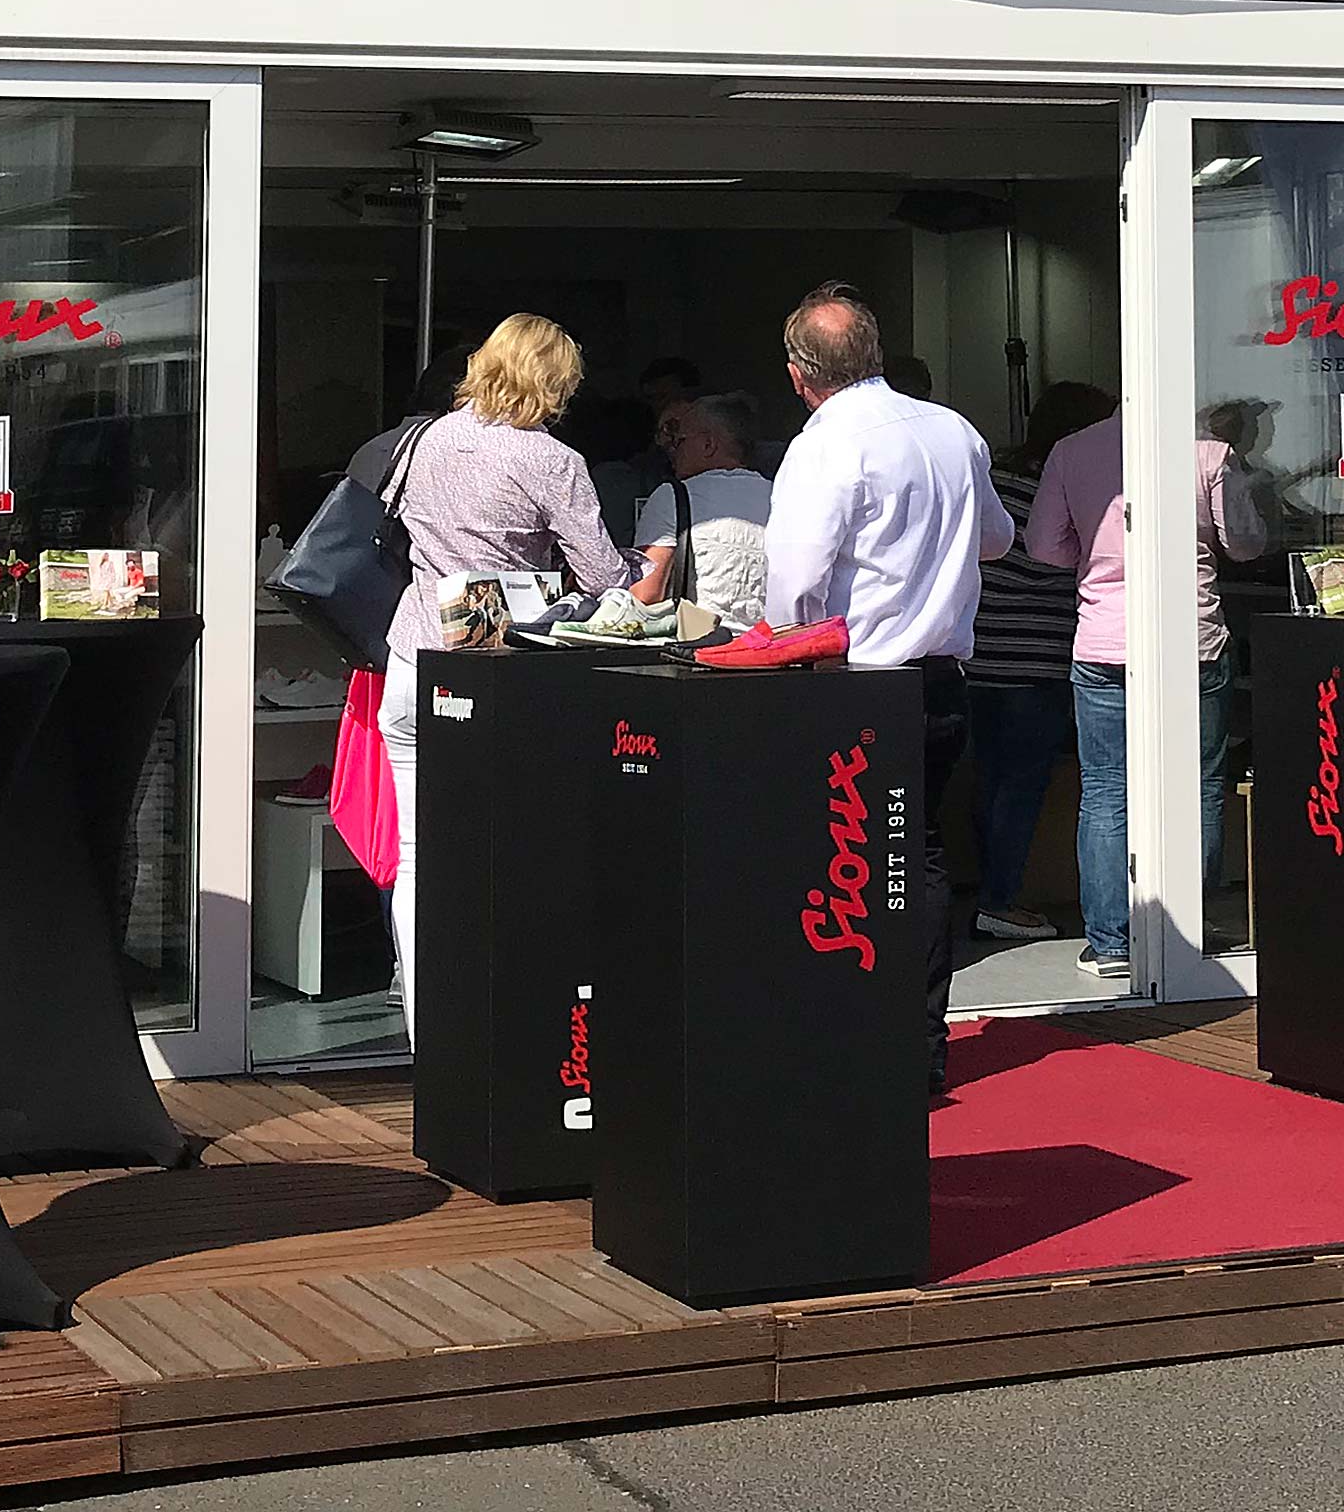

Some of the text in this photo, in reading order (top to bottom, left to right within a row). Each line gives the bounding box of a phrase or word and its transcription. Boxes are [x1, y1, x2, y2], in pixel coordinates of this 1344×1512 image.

[612, 719, 657, 756] Sioux
[1308, 678, 1344, 857] Sioux
[800, 744, 875, 972] Sioux
[887, 787, 905, 910] SEIT 1954
[560, 1004, 590, 1094] Sioux
